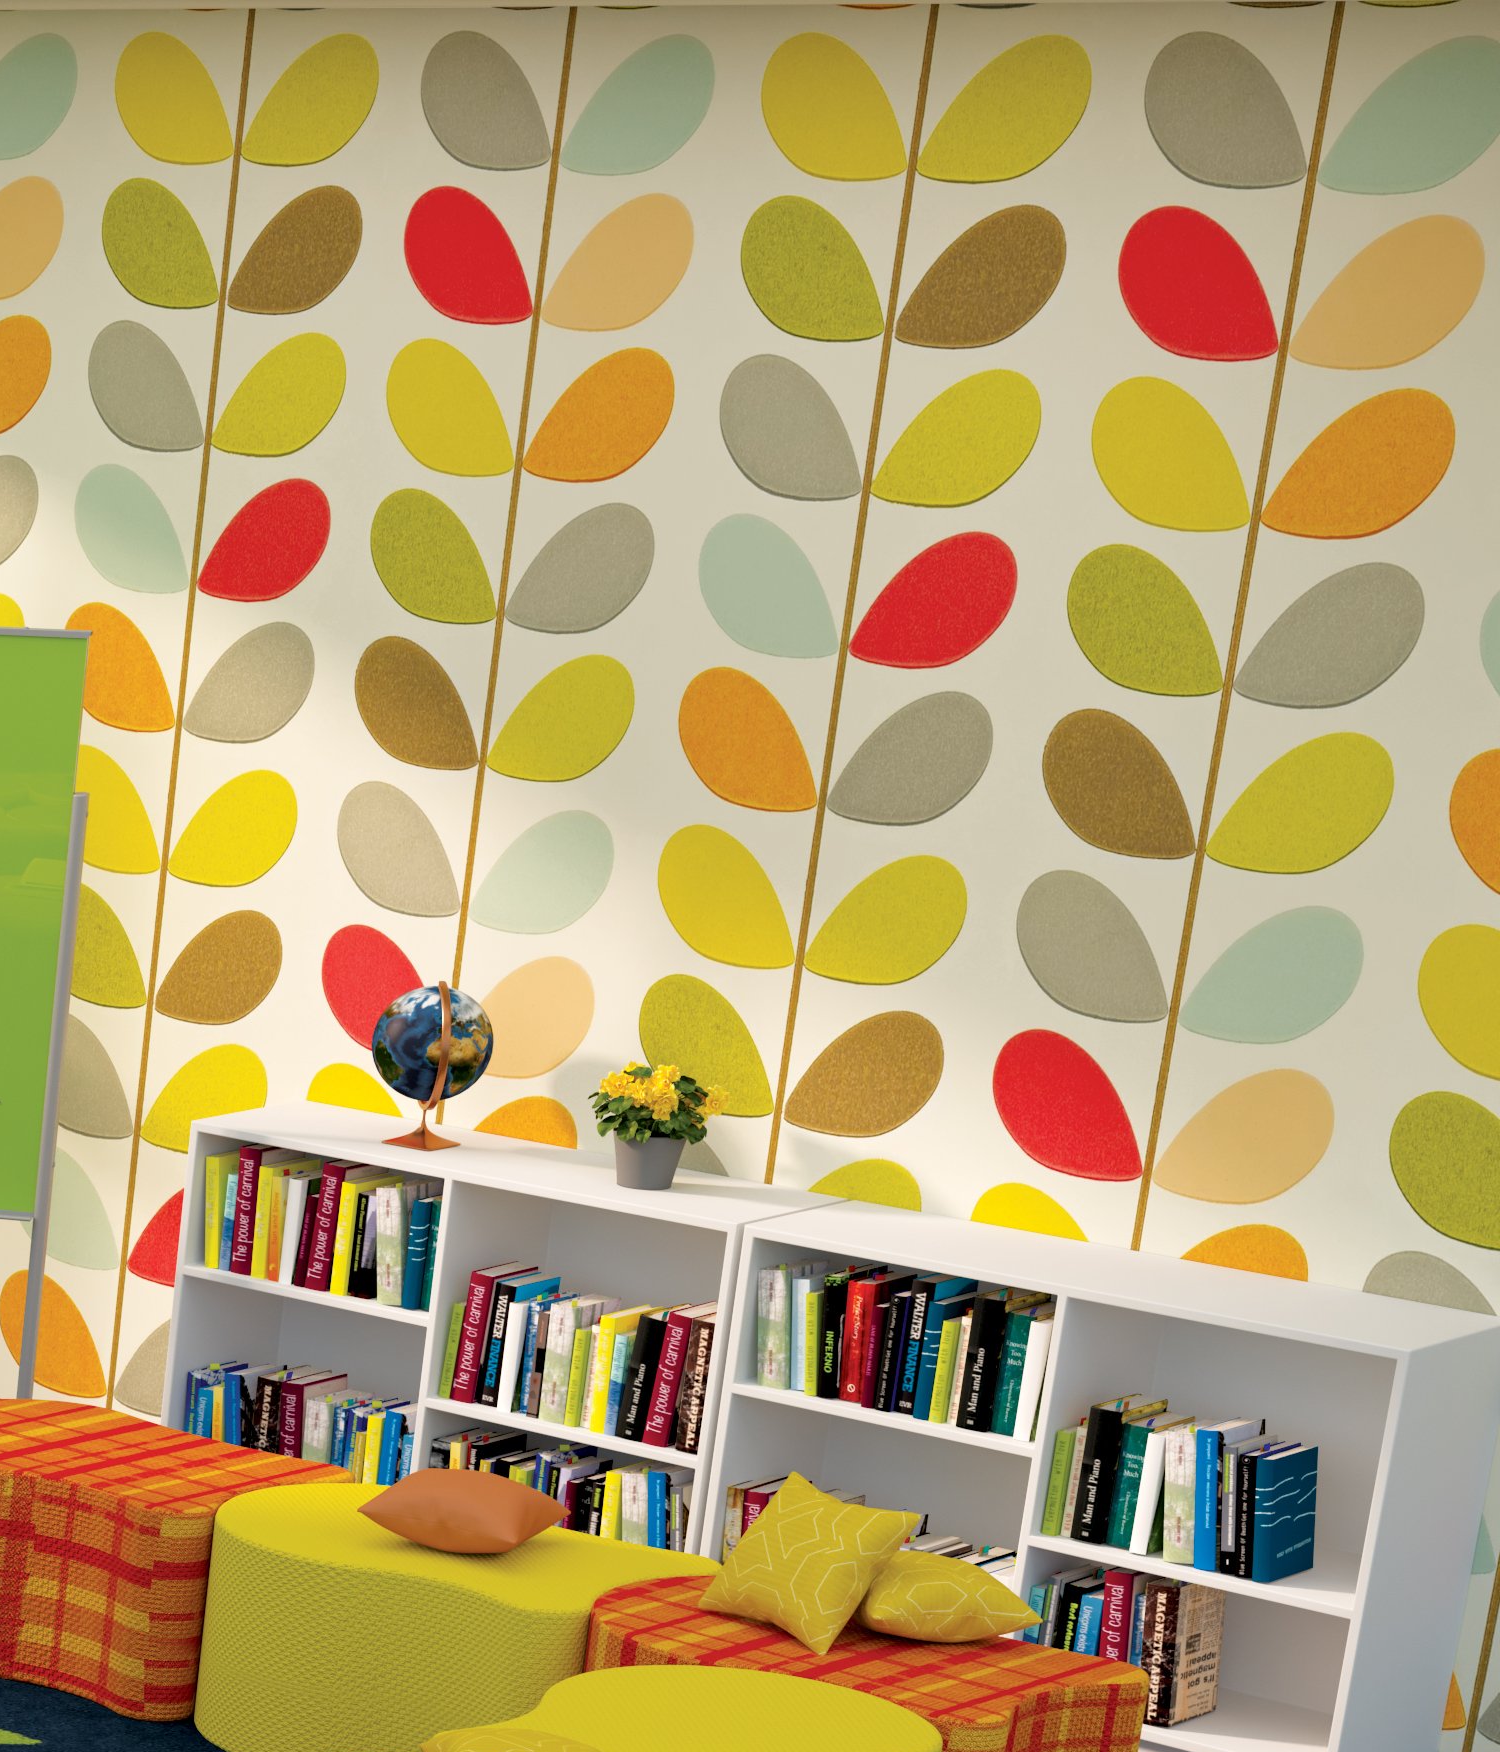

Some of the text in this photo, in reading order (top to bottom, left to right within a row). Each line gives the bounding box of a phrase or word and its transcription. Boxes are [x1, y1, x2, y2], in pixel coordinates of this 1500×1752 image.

[232, 1158, 254, 1262] The power of carnival
[307, 1174, 338, 1279] The power of carnival
[453, 1283, 486, 1390] The power of carnival
[485, 1294, 509, 1388] WALTER FINANCE
[852, 1295, 864, 1340] Perfect Story
[902, 1292, 927, 1393] WALTER FINANCE
[646, 1323, 684, 1434] The power of carnival
[824, 1330, 834, 1374] INFERNO
[967, 1347, 985, 1413] Man and Piano
[282, 1393, 297, 1432] carnival
[627, 1364, 647, 1424] Man and Piano
[686, 1328, 709, 1449] MAGNETIC APPEAL
[281, 1432, 295, 1445] of
[1082, 1459, 1101, 1524] Man and Piano
[1069, 1602, 1079, 1621] Best
[1081, 1605, 1093, 1634] Unicorns
[1102, 1627, 1120, 1642] of
[1107, 1583, 1124, 1627] carnival
[1147, 1592, 1167, 1721] MAGNETIC APPEAL
[1180, 1663, 1216, 1681] magnetic
